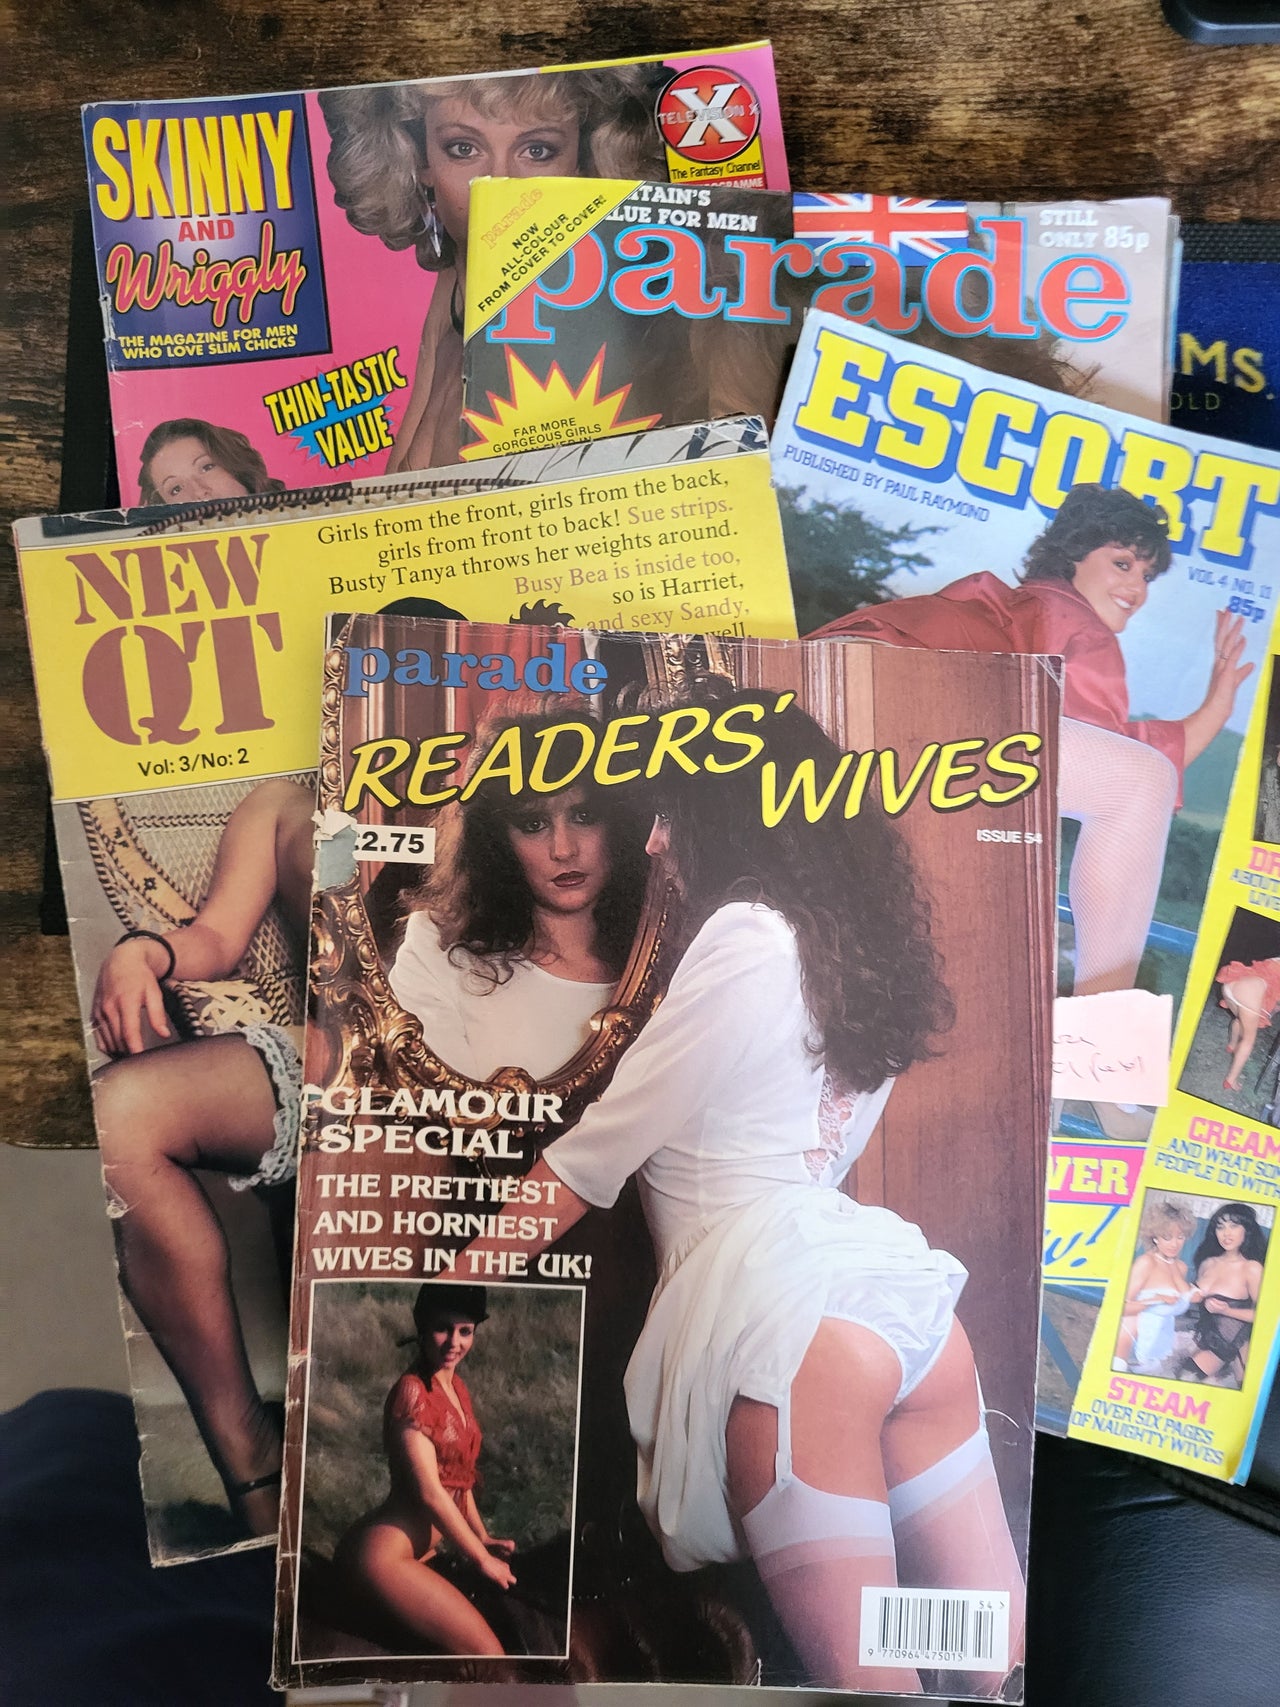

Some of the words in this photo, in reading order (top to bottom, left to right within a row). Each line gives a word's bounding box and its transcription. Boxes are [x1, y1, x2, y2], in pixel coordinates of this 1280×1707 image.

[657, 105, 745, 125] TELEVISION
[670, 82, 748, 147] X
[92, 110, 293, 220] SKINNY
[671, 168, 687, 179] The
[690, 165, 723, 178] Fantasy
[726, 160, 761, 173] Channel
[178, 219, 235, 242] AND
[480, 188, 543, 250] parade
[605, 205, 651, 223] LUE
[658, 208, 701, 227] FOR
[707, 212, 758, 232] MEN
[1039, 209, 1098, 226] STILL
[477, 281, 512, 312] FROM
[511, 246, 550, 282] COVER
[548, 231, 565, 247] TO
[565, 194, 607, 233] COVER!
[500, 213, 569, 277] ALL-COLOUR
[512, 222, 539, 250] NOW
[1039, 231, 1099, 248] ONLY
[1103, 225, 1150, 253] 85p
[106, 221, 307, 327] Wriggly
[486, 216, 1132, 344] parade
[118, 335, 145, 348] THE
[149, 330, 229, 346] MAGAZINE
[233, 327, 262, 341] FOR
[266, 324, 298, 337] MEN
[122, 346, 163, 359] WHO
[167, 344, 204, 358] LOVE
[209, 341, 241, 355] SLIM
[245, 336, 297, 351] CHICKS
[263, 346, 408, 435] THIN-TASTIC
[314, 406, 395, 469] VALUE
[493, 430, 562, 453] GORGEOUS
[565, 423, 602, 438] GIRLS
[513, 425, 537, 437] FAR
[540, 417, 577, 432] MORE
[794, 328, 1280, 570] ESCORT
[783, 444, 861, 482] PUBLISHED
[862, 471, 884, 490] BY
[883, 478, 919, 502] PAUL
[920, 490, 990, 523] RAYMOND
[317, 522, 368, 545] Girls
[373, 518, 423, 537] from
[429, 509, 461, 529] the
[466, 500, 523, 524] front,
[529, 491, 573, 518] girls
[578, 486, 628, 506] from
[634, 477, 667, 498] the
[672, 469, 729, 492] back,
[378, 543, 422, 568] girls
[427, 537, 476, 556] from
[481, 523, 532, 547] front
[537, 522, 558, 538] to
[562, 509, 621, 534] back!
[627, 505, 665, 525] Sue
[671, 497, 734, 521] strips.
[329, 573, 387, 596] Busty
[391, 564, 456, 585] Tanya
[462, 552, 530, 577] throws
[536, 545, 569, 564] her
[574, 532, 652, 557] weights
[658, 519, 738, 546] around.
[514, 574, 563, 596] Busy
[569, 567, 608, 587] Bea
[613, 561, 630, 580] is
[635, 552, 697, 577] inside
[701, 549, 741, 567] too,
[65, 533, 270, 625] NEW
[612, 589, 634, 605] so
[639, 582, 655, 600] is
[661, 571, 744, 598] Harriet,
[1217, 575, 1228, 588] 4
[587, 612, 624, 632] and
[631, 609, 674, 629] sexy
[680, 596, 750, 622] Sandy,
[1229, 595, 1267, 624] 85p
[82, 611, 284, 746] QT
[342, 643, 609, 697] parade
[138, 759, 175, 777] Vol:
[179, 751, 233, 773] 3/No:
[237, 747, 250, 764] 2
[343, 690, 797, 812] READERS'
[759, 731, 1043, 829] WIVES
[355, 831, 425, 854] 2.75
[976, 829, 1022, 843] ISSUE
[1024, 832, 1043, 844] 54
[319, 1086, 564, 1123] GLAMOUR
[319, 1124, 524, 1159] SPECIAL
[1205, 1147, 1254, 1172] WHAT
[1154, 1151, 1215, 1180] PEOPLE
[1217, 1168, 1239, 1187] DO
[316, 1174, 381, 1198] THE
[389, 1174, 561, 1205] PRETTIEST
[312, 1210, 383, 1235] AND
[392, 1211, 558, 1241] HORNIEST
[310, 1246, 413, 1272] WIVES
[423, 1248, 456, 1273] IN
[465, 1250, 528, 1276] THE
[537, 1253, 593, 1279] UK!
[1107, 1376, 1212, 1425] STEAM
[1071, 1411, 1092, 1428] OF
[1091, 1416, 1170, 1449] NAUGHTY
[1171, 1437, 1225, 1466] WIVES
[1091, 1399, 1133, 1423] OVER
[1135, 1410, 1160, 1430] SIX
[1164, 1417, 1215, 1446] PAGES
[978, 1600, 993, 1610] 54
[867, 1648, 874, 1657] 9
[882, 1649, 920, 1660] 770964
[924, 1652, 963, 1662] 475015
